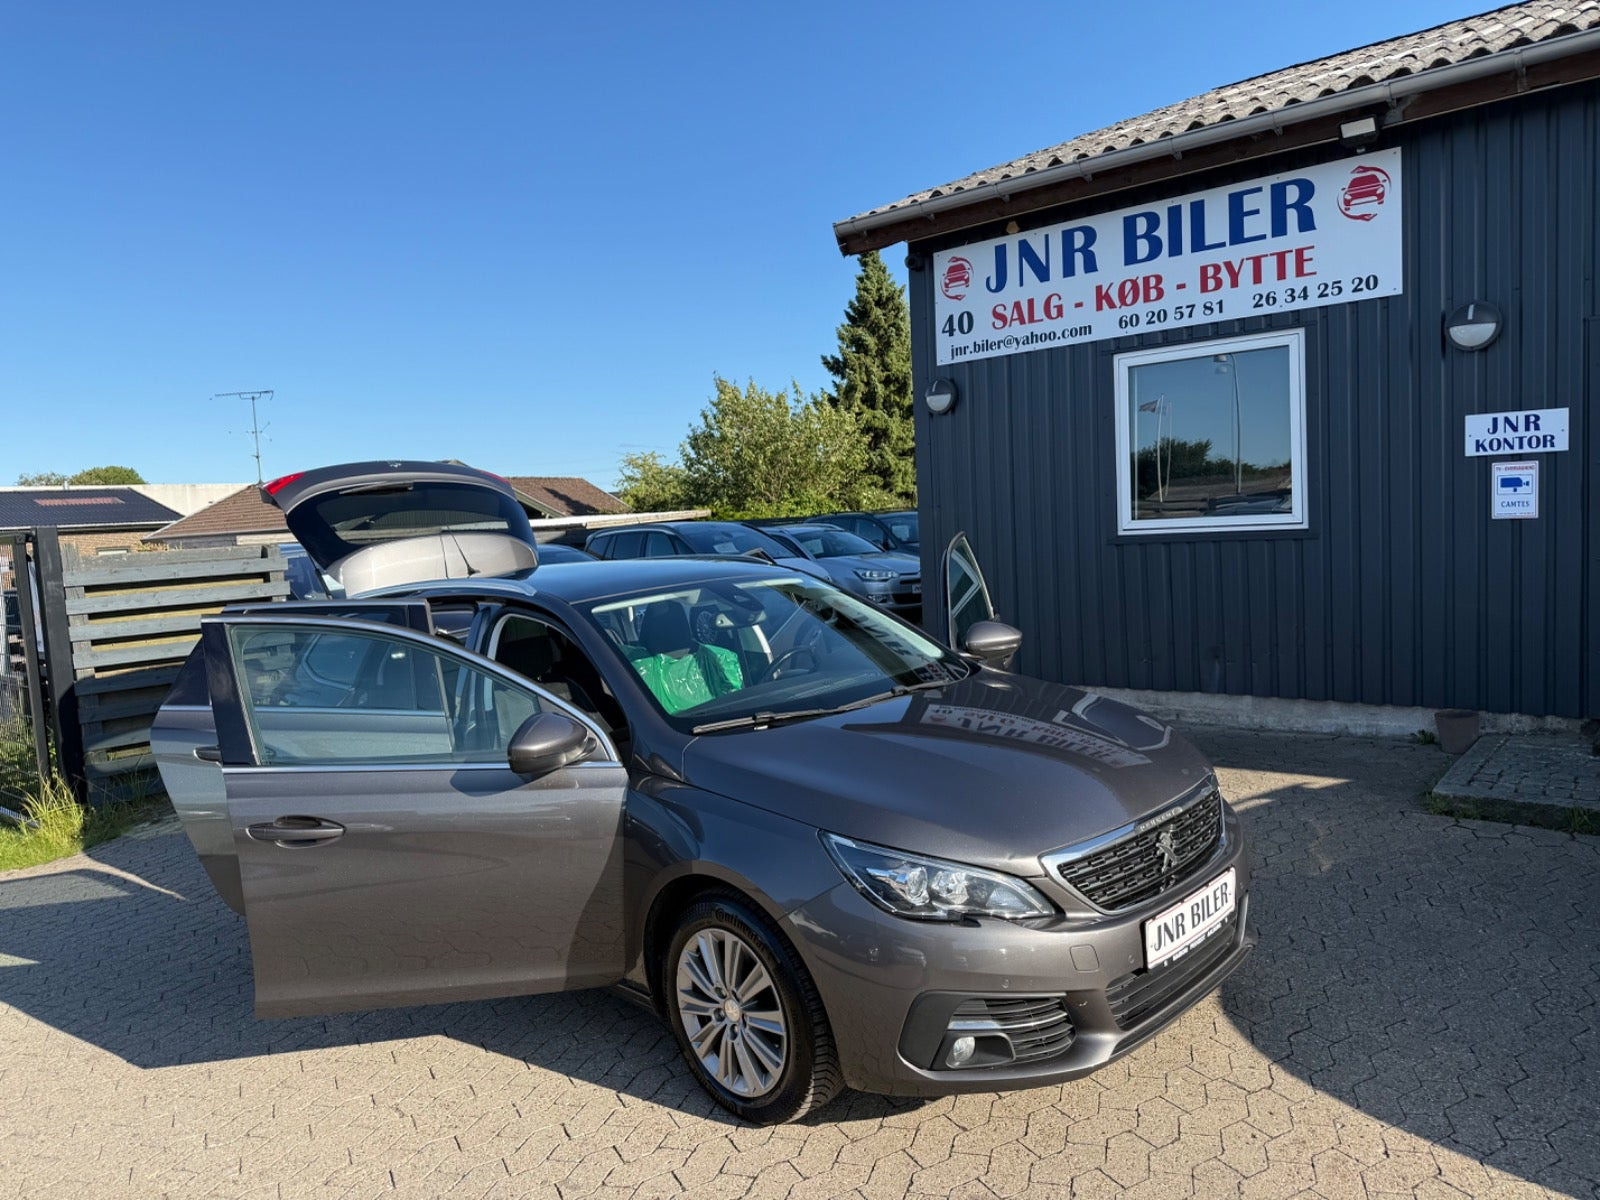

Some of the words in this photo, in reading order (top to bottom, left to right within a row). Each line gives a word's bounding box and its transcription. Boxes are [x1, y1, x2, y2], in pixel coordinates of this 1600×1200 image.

[985, 224, 1099, 294] JNR
[1122, 177, 1318, 267] BILER
[991, 293, 1064, 331] SALG
[1095, 273, 1165, 312] KØB
[1199, 245, 1318, 294] BYTTE
[1252, 291, 1278, 309] 26
[1284, 285, 1310, 304] 34
[1317, 279, 1343, 299] 25
[1351, 274, 1379, 294] 20
[941, 310, 975, 338] 40
[1118, 313, 1140, 330] 60
[1145, 308, 1168, 326] 20
[1173, 303, 1196, 321] 57
[1202, 299, 1224, 317] 81
[950, 324, 1093, 361] jnr.biler@yahoo.com
[1487, 413, 1541, 435] JNR
[1475, 434, 1556, 453] KONTOR
[1153, 912, 1186, 952] JNR
[1190, 881, 1228, 930] BILER
